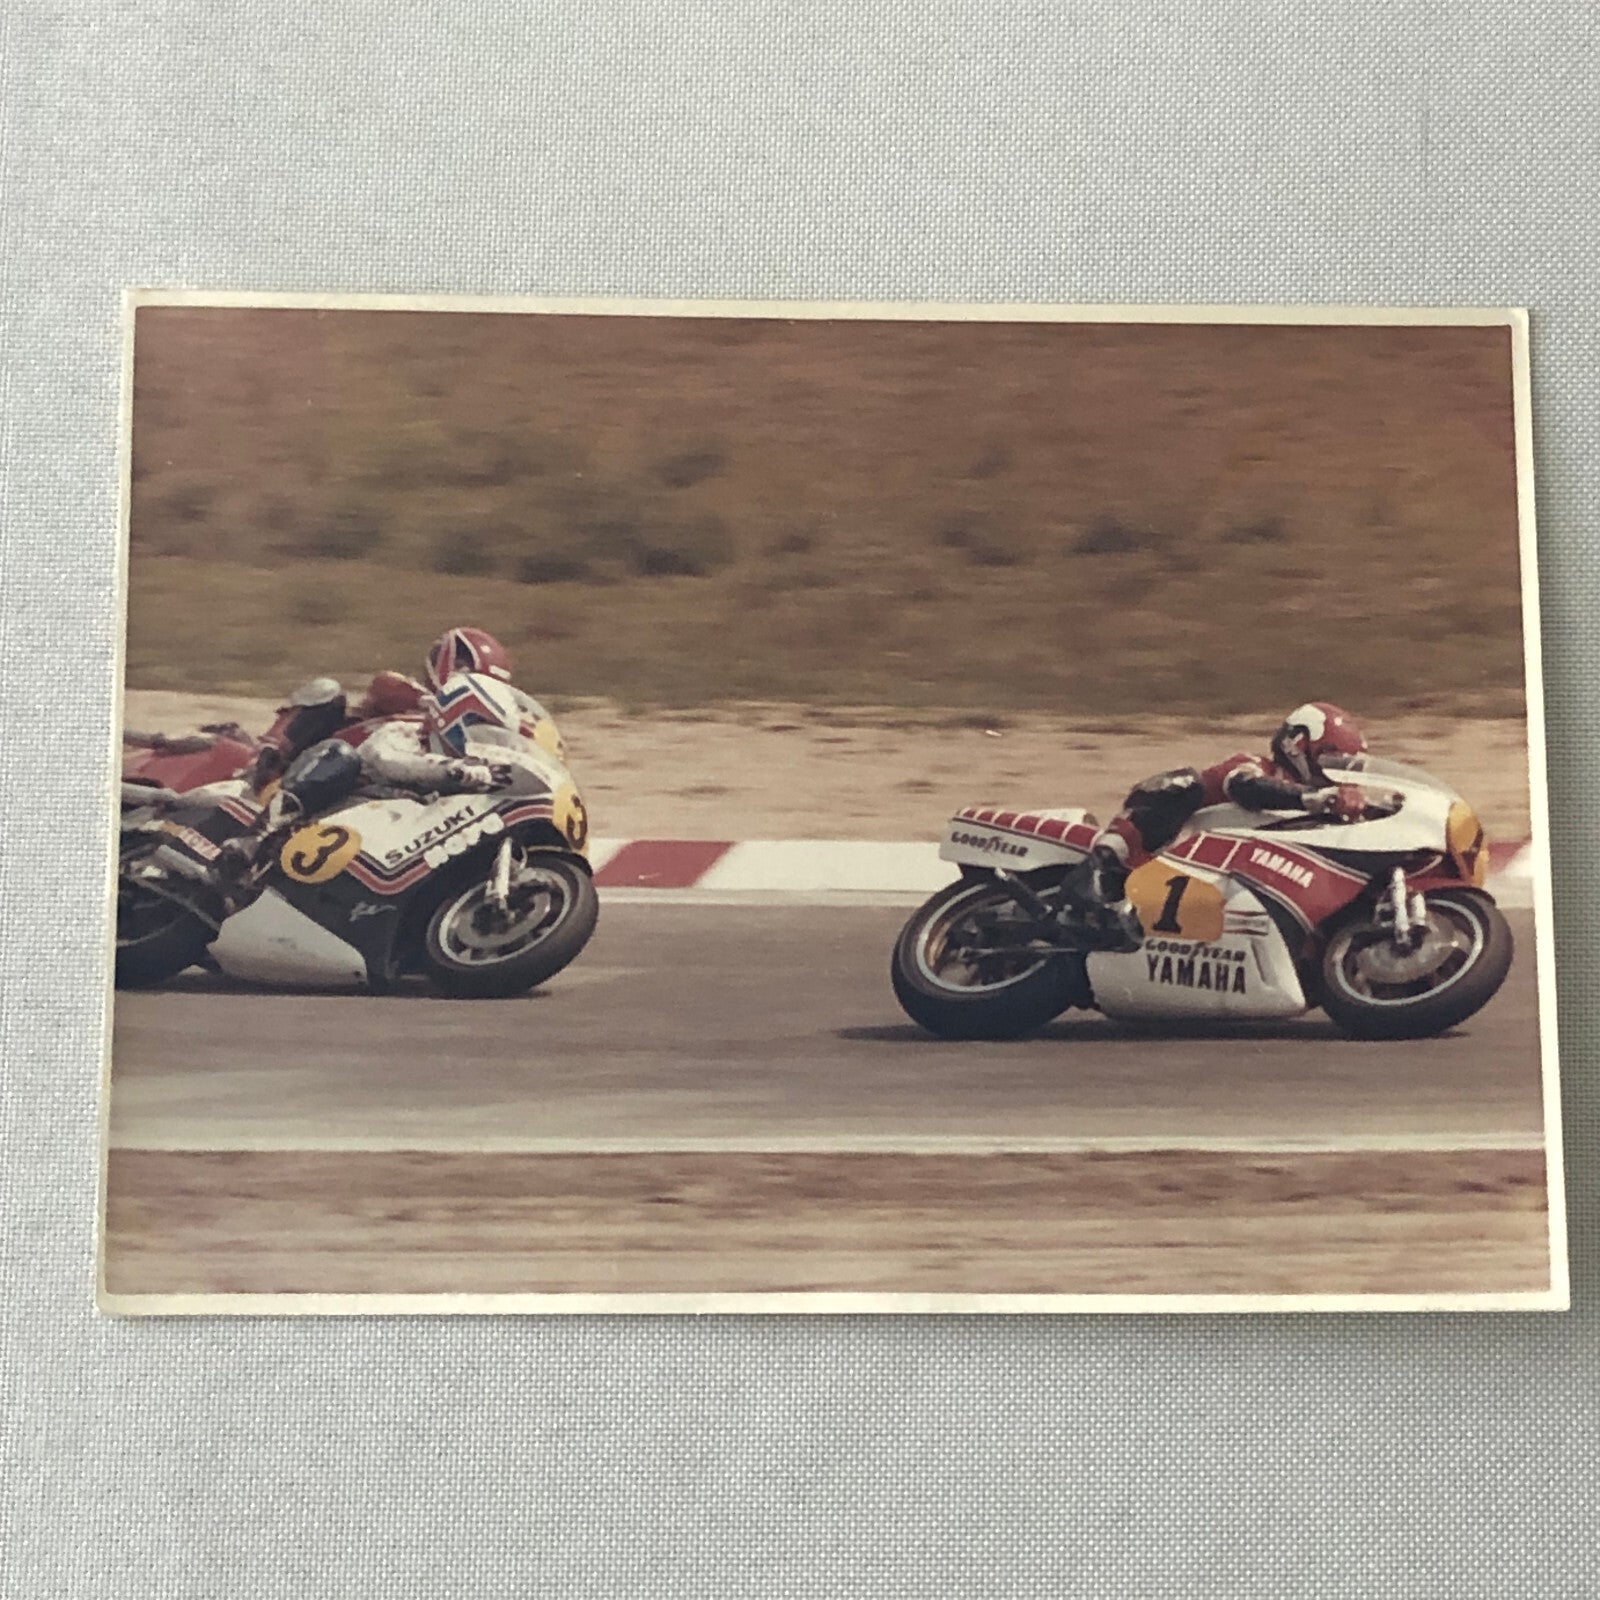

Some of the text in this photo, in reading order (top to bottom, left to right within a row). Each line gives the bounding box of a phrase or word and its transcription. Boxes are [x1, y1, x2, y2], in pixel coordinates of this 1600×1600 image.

[291, 825, 349, 876] 3
[385, 805, 475, 864] SUZUKI
[951, 831, 1029, 857] GOODYEAR
[1249, 847, 1314, 889] YAMAHA
[1152, 875, 1190, 934] 1
[1145, 939, 1246, 962] GOODYEAR
[1147, 954, 1246, 994] YAMAHA
